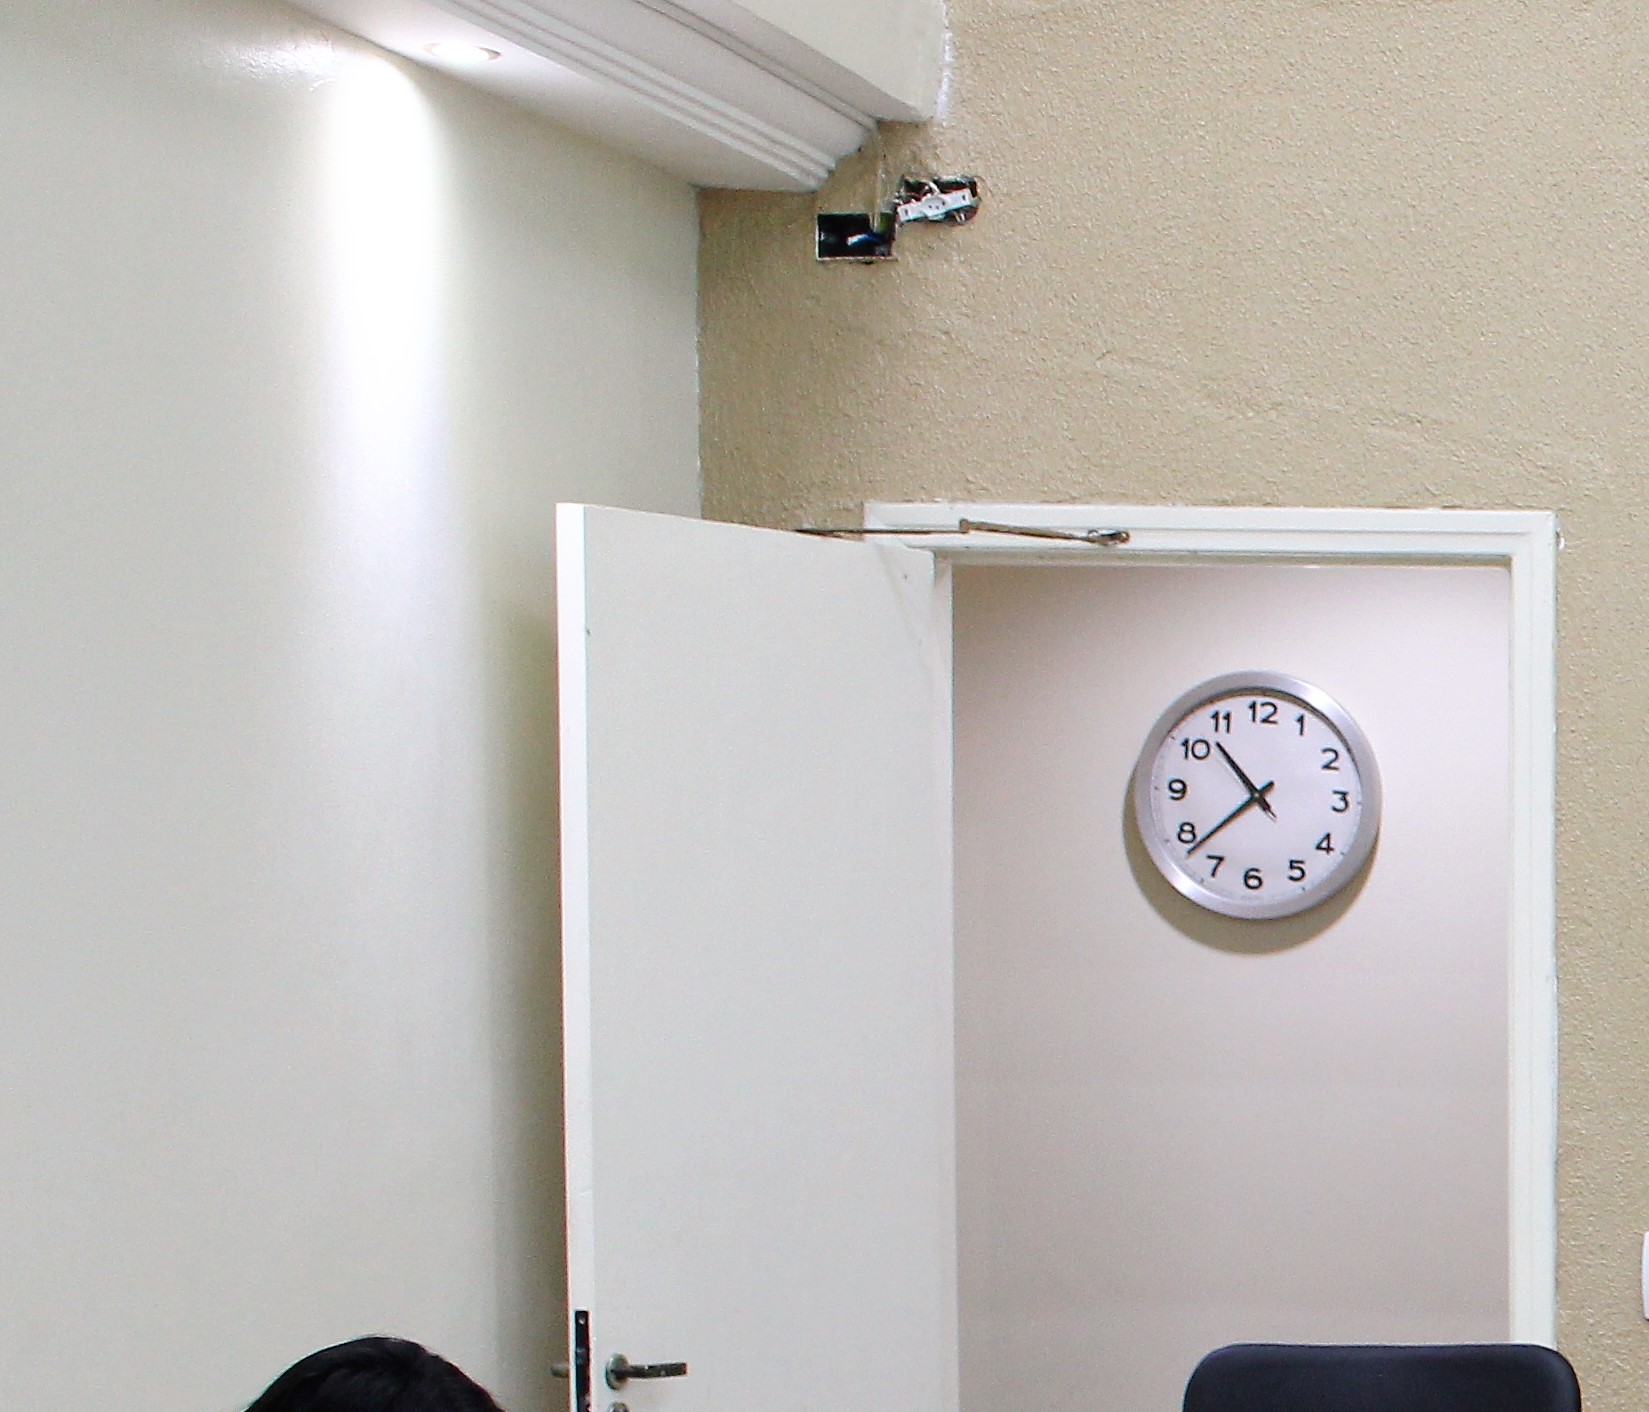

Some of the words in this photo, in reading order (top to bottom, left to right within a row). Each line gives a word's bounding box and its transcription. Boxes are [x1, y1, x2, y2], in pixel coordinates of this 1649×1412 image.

[1211, 710, 1231, 733] 11
[1248, 701, 1278, 724] 12
[1296, 714, 1305, 736] 1
[1181, 738, 1211, 760] 10
[1321, 748, 1340, 771] 2
[1168, 779, 1187, 800] 9
[1331, 790, 1350, 813] 3
[1177, 822, 1197, 843] 8
[1315, 832, 1335, 855] 4
[1206, 855, 1225, 878] 7
[1287, 860, 1306, 882] 5
[1243, 868, 1263, 890] 6
